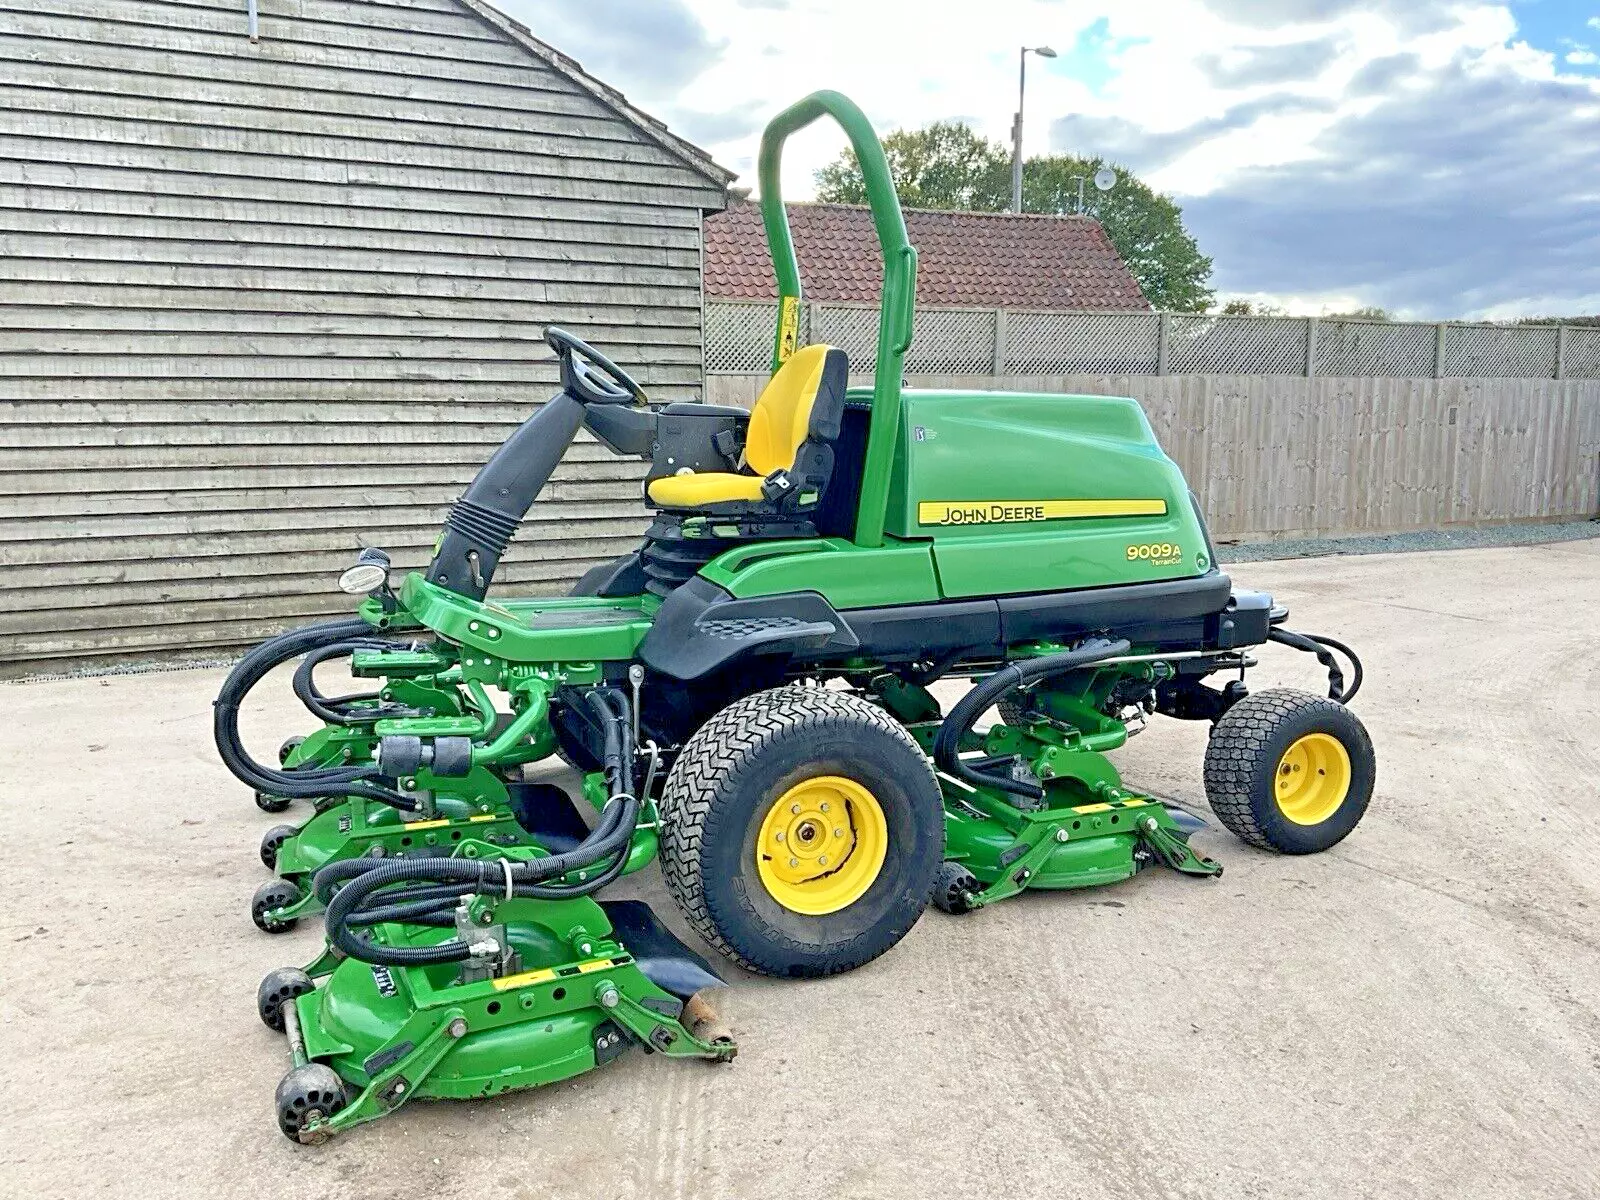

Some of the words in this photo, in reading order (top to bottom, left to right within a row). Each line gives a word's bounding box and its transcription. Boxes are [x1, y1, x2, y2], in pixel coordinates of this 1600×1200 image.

[941, 508, 987, 523] JOHN
[991, 505, 1045, 521] DEERE
[1151, 558, 1182, 566] TerrainCut
